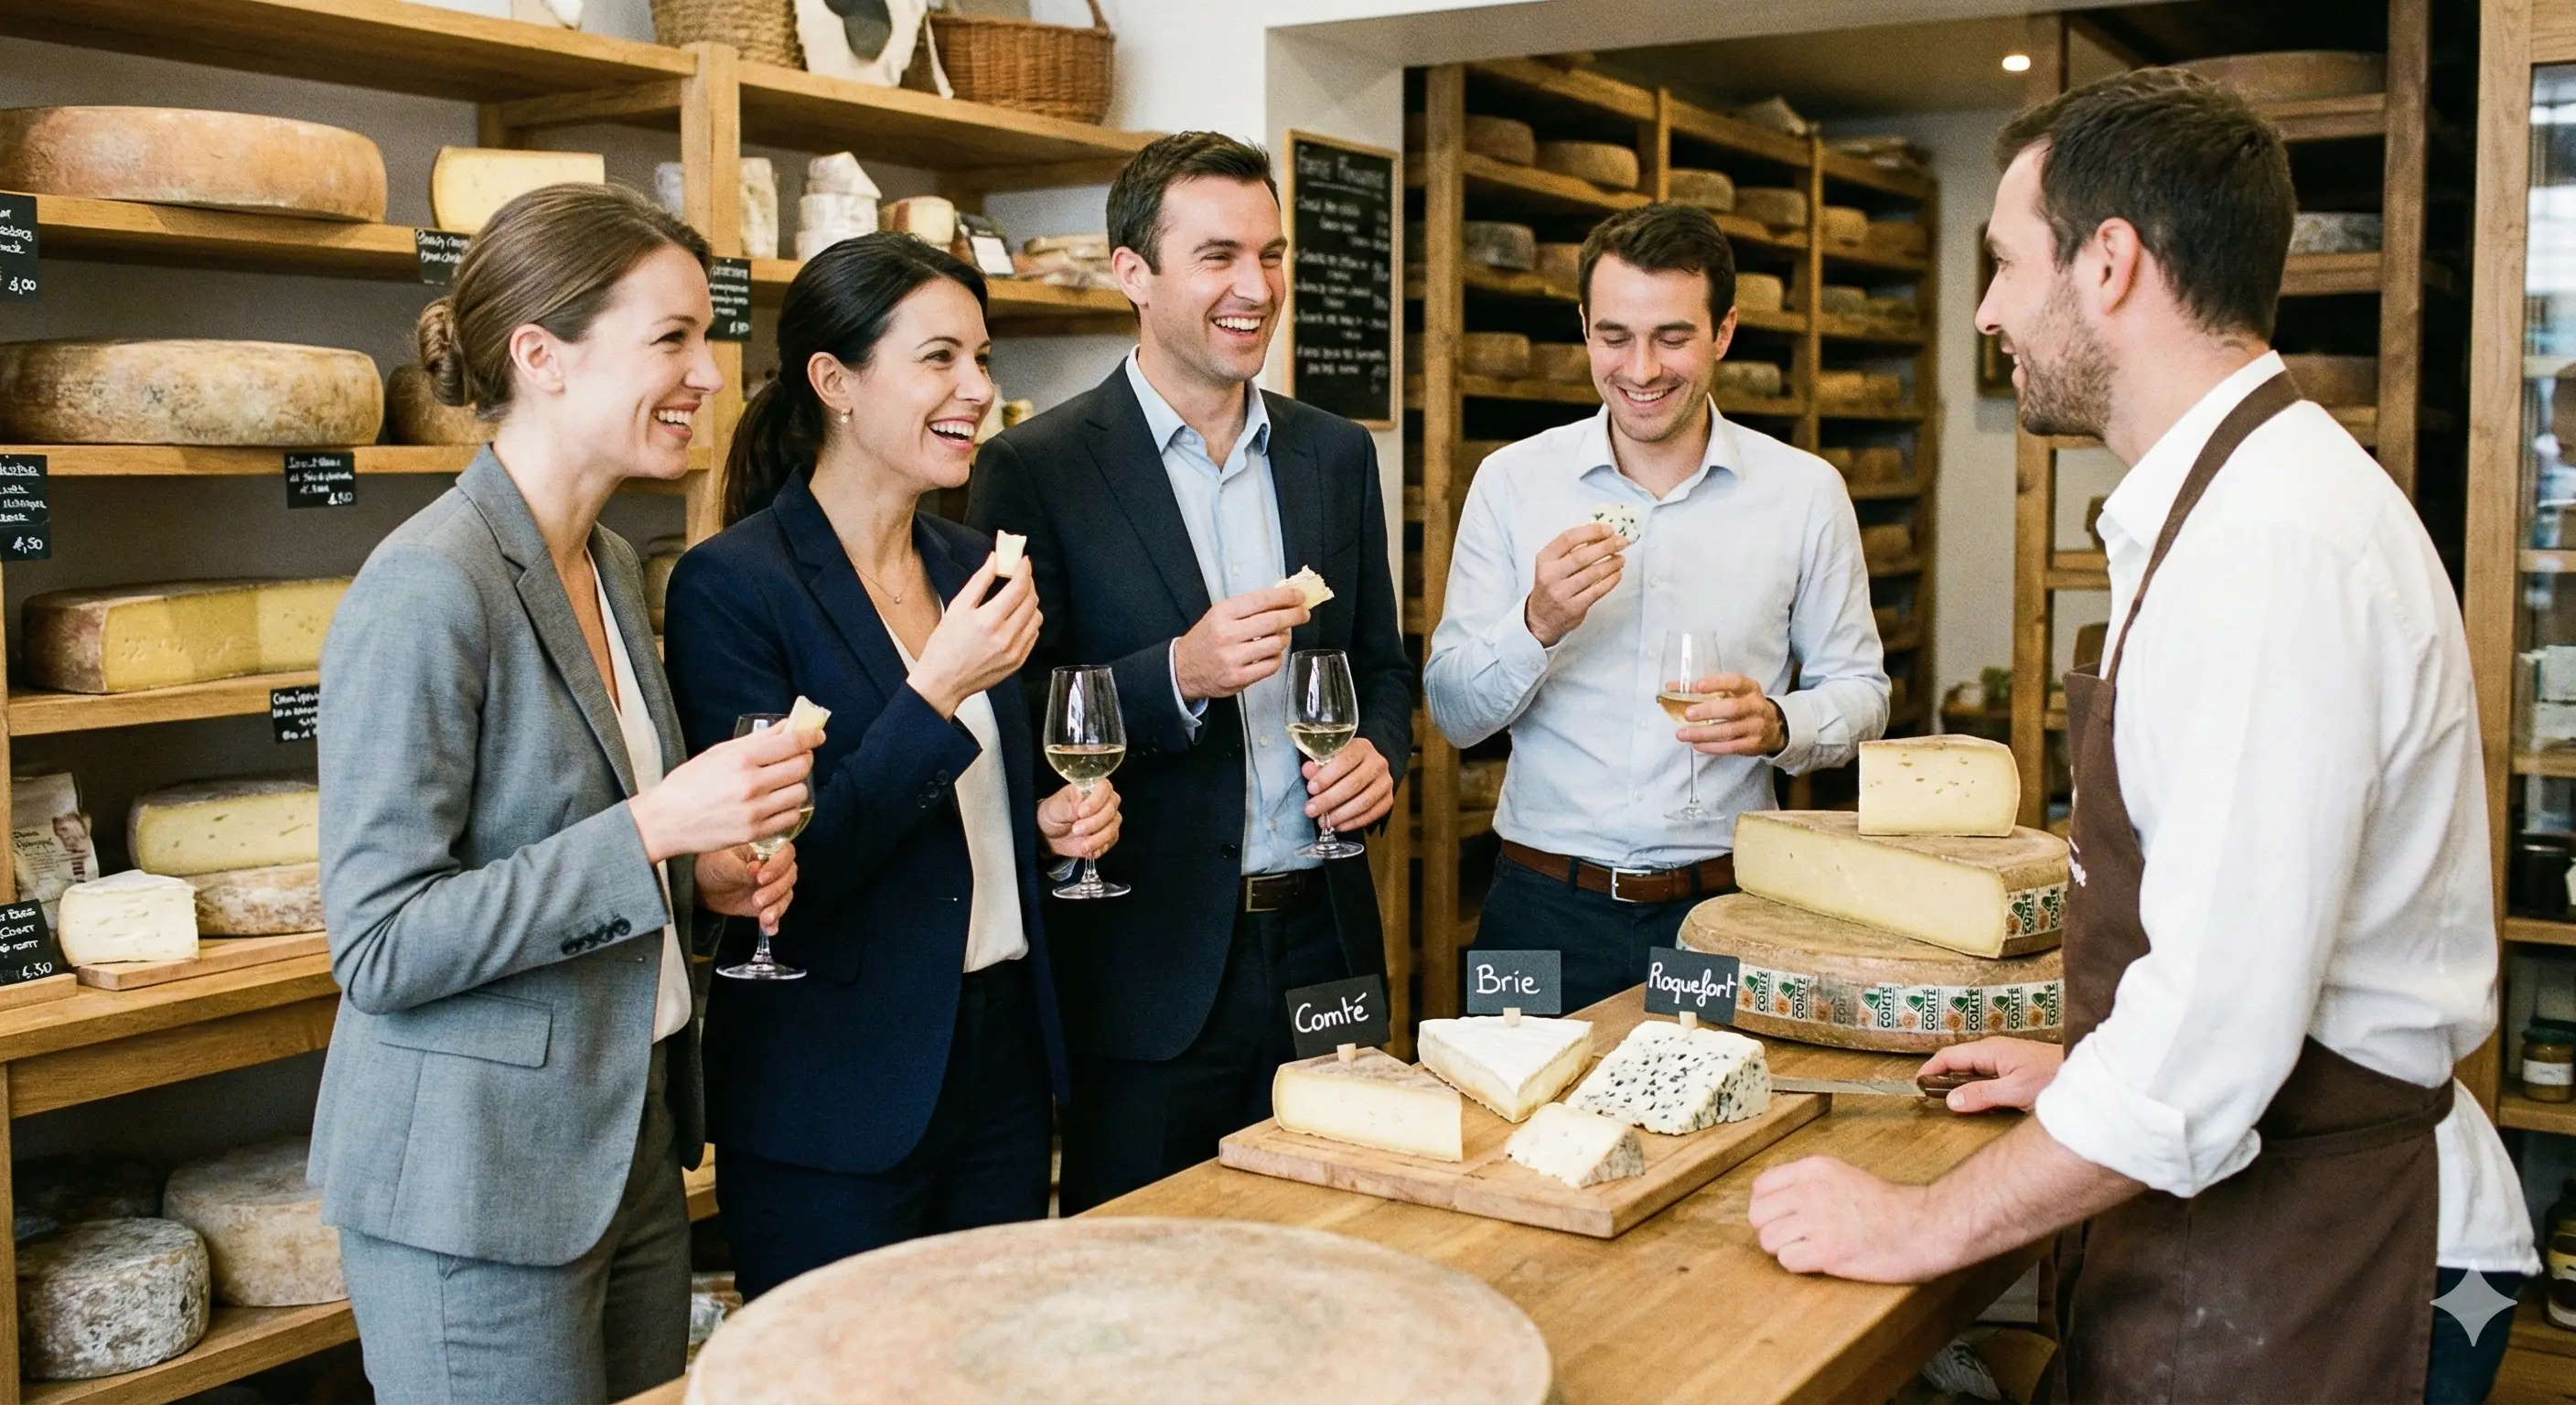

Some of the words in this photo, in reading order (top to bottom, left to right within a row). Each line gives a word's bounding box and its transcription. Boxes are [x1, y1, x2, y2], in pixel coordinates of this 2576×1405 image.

[1476, 963, 1540, 994] Brie
[1648, 961, 1737, 1007] Roquefort
[1294, 992, 1369, 1034] Comté
